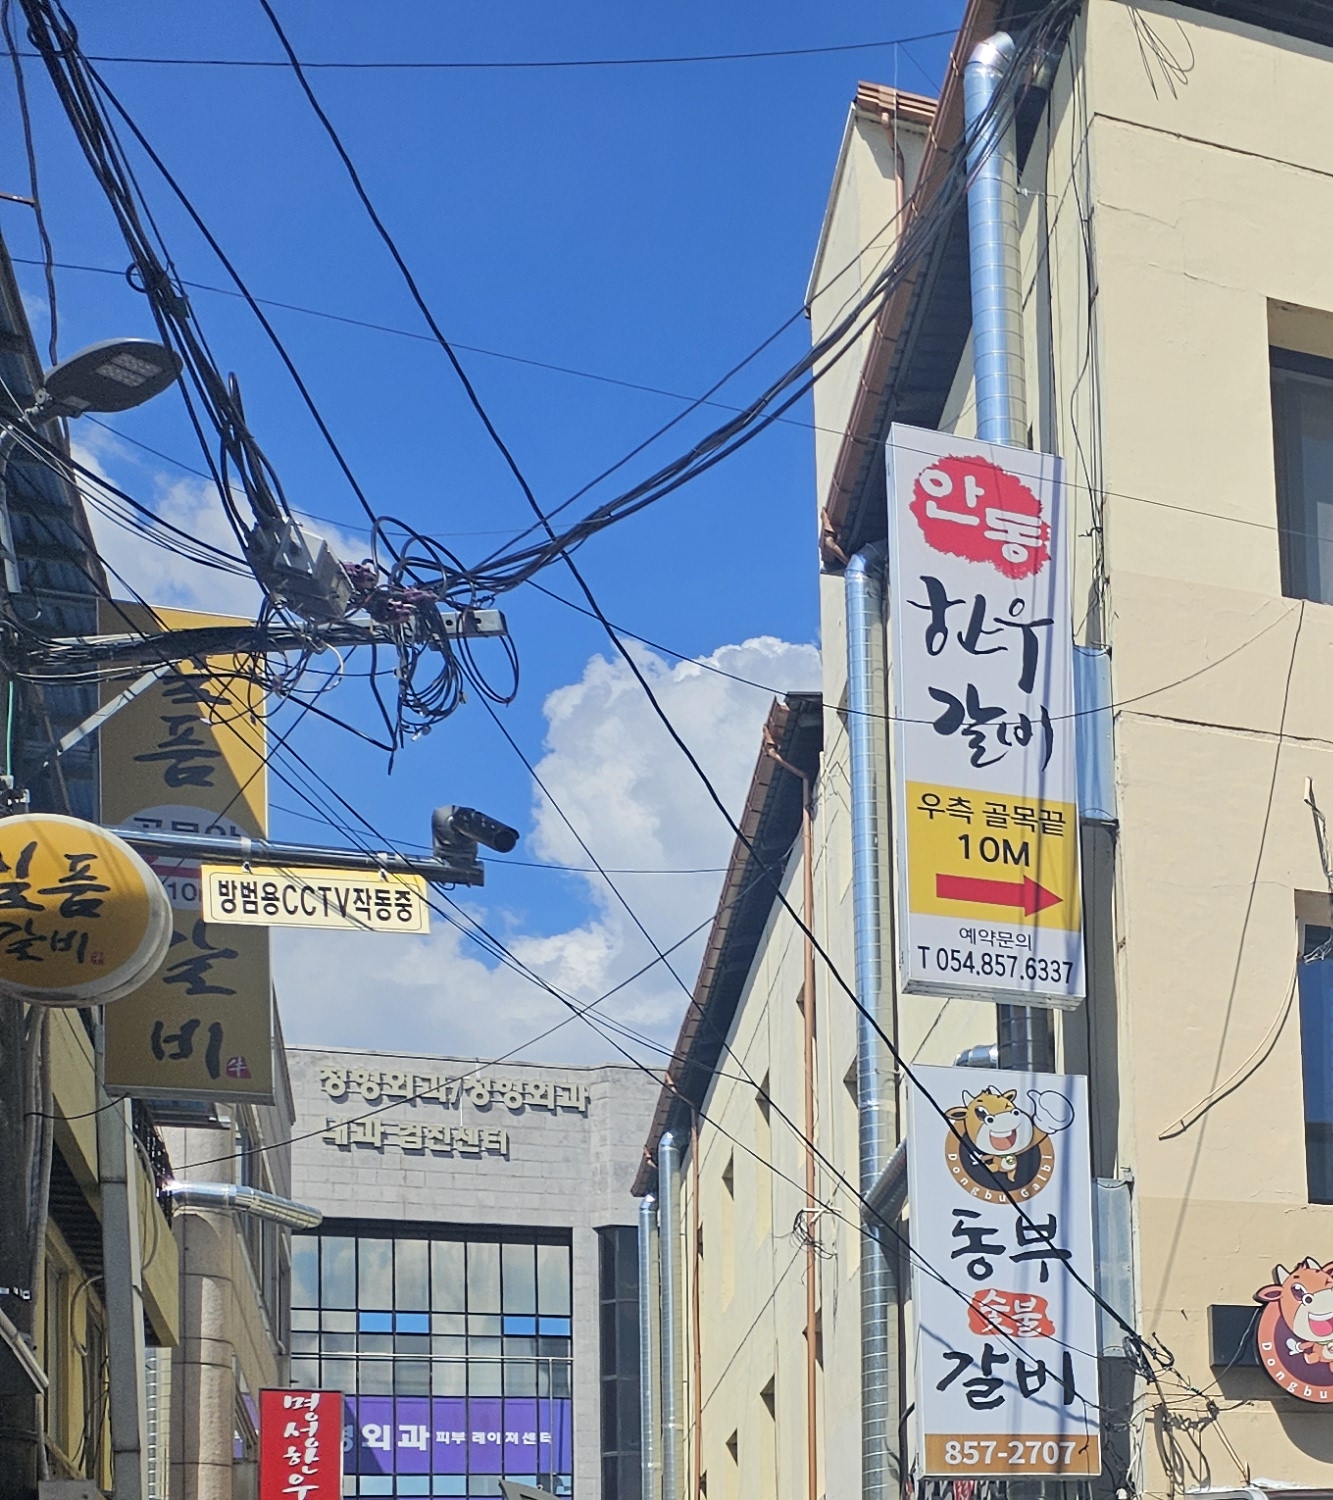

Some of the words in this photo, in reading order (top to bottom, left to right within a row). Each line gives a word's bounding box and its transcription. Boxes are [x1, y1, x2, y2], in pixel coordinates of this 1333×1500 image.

[918, 467, 1043, 563] 안동
[906, 575, 1054, 695] 한우
[928, 683, 1054, 772] 갈비
[918, 792, 974, 824] 우측
[983, 802, 1066, 837] 골목끝
[957, 833, 1031, 868] 10M
[217, 880, 413, 922] 방범용CCTV작동중
[958, 926, 1033, 952] 예약문의
[936, 947, 1074, 985] 054.857.6337
[1020, 1155, 1053, 1197] Galbi
[950, 1208, 1074, 1283] 동부
[977, 1288, 1042, 1337] 숯불
[936, 1342, 1075, 1411] 갈비
[1261, 1342, 1327, 1399] Dongbu
[944, 1440, 1076, 1467] 857-2707
